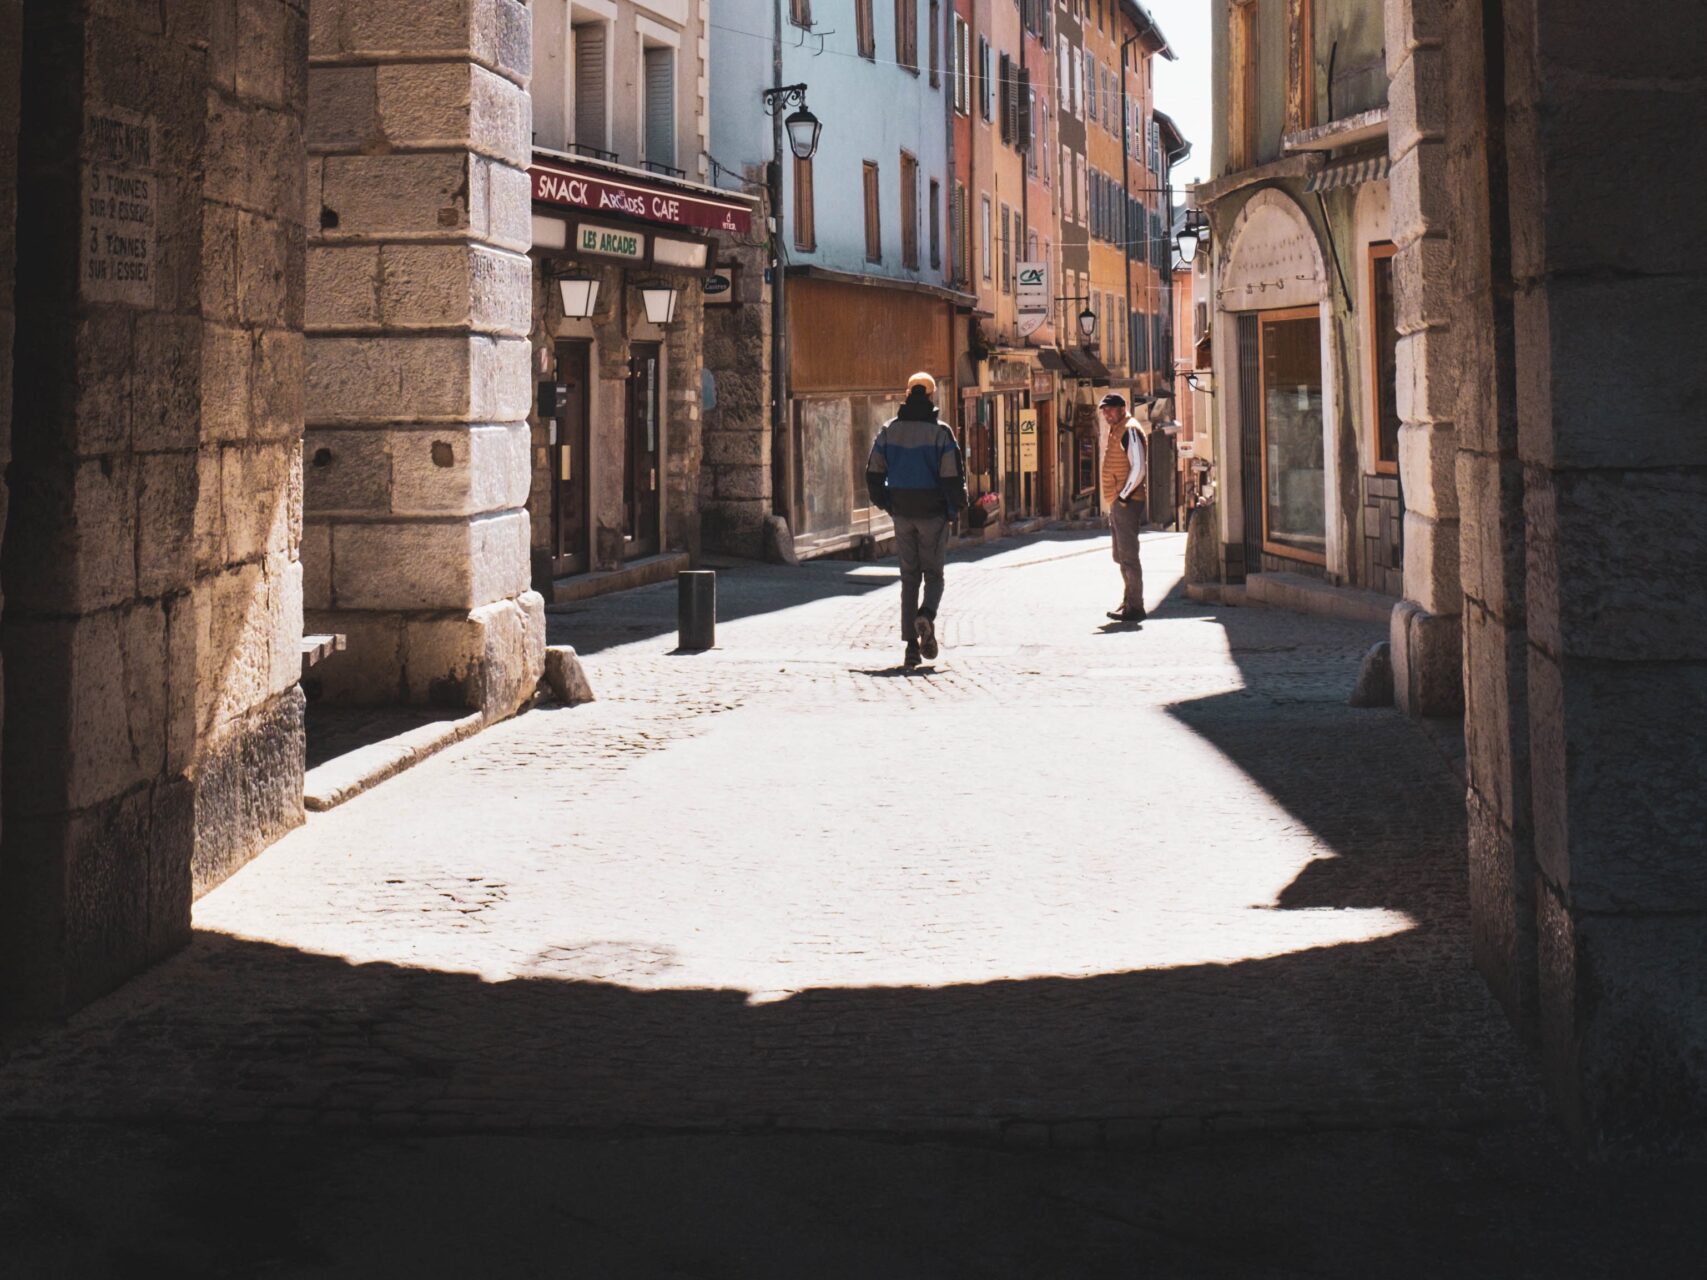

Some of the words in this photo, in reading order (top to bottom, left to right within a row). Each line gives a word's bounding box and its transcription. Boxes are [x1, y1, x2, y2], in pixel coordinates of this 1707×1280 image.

[107, 174, 148, 200] TONNES
[537, 175, 588, 205] SNACK
[599, 188, 645, 215] ARCADES
[652, 196, 680, 221] CAFE
[90, 198, 105, 217] SUR
[90, 225, 98, 254] 3
[106, 234, 147, 258] TONNES
[583, 229, 597, 250] LES
[600, 233, 637, 255] ARCADES
[89, 259, 106, 280] SUR
[117, 261, 148, 281] ESSIEU
